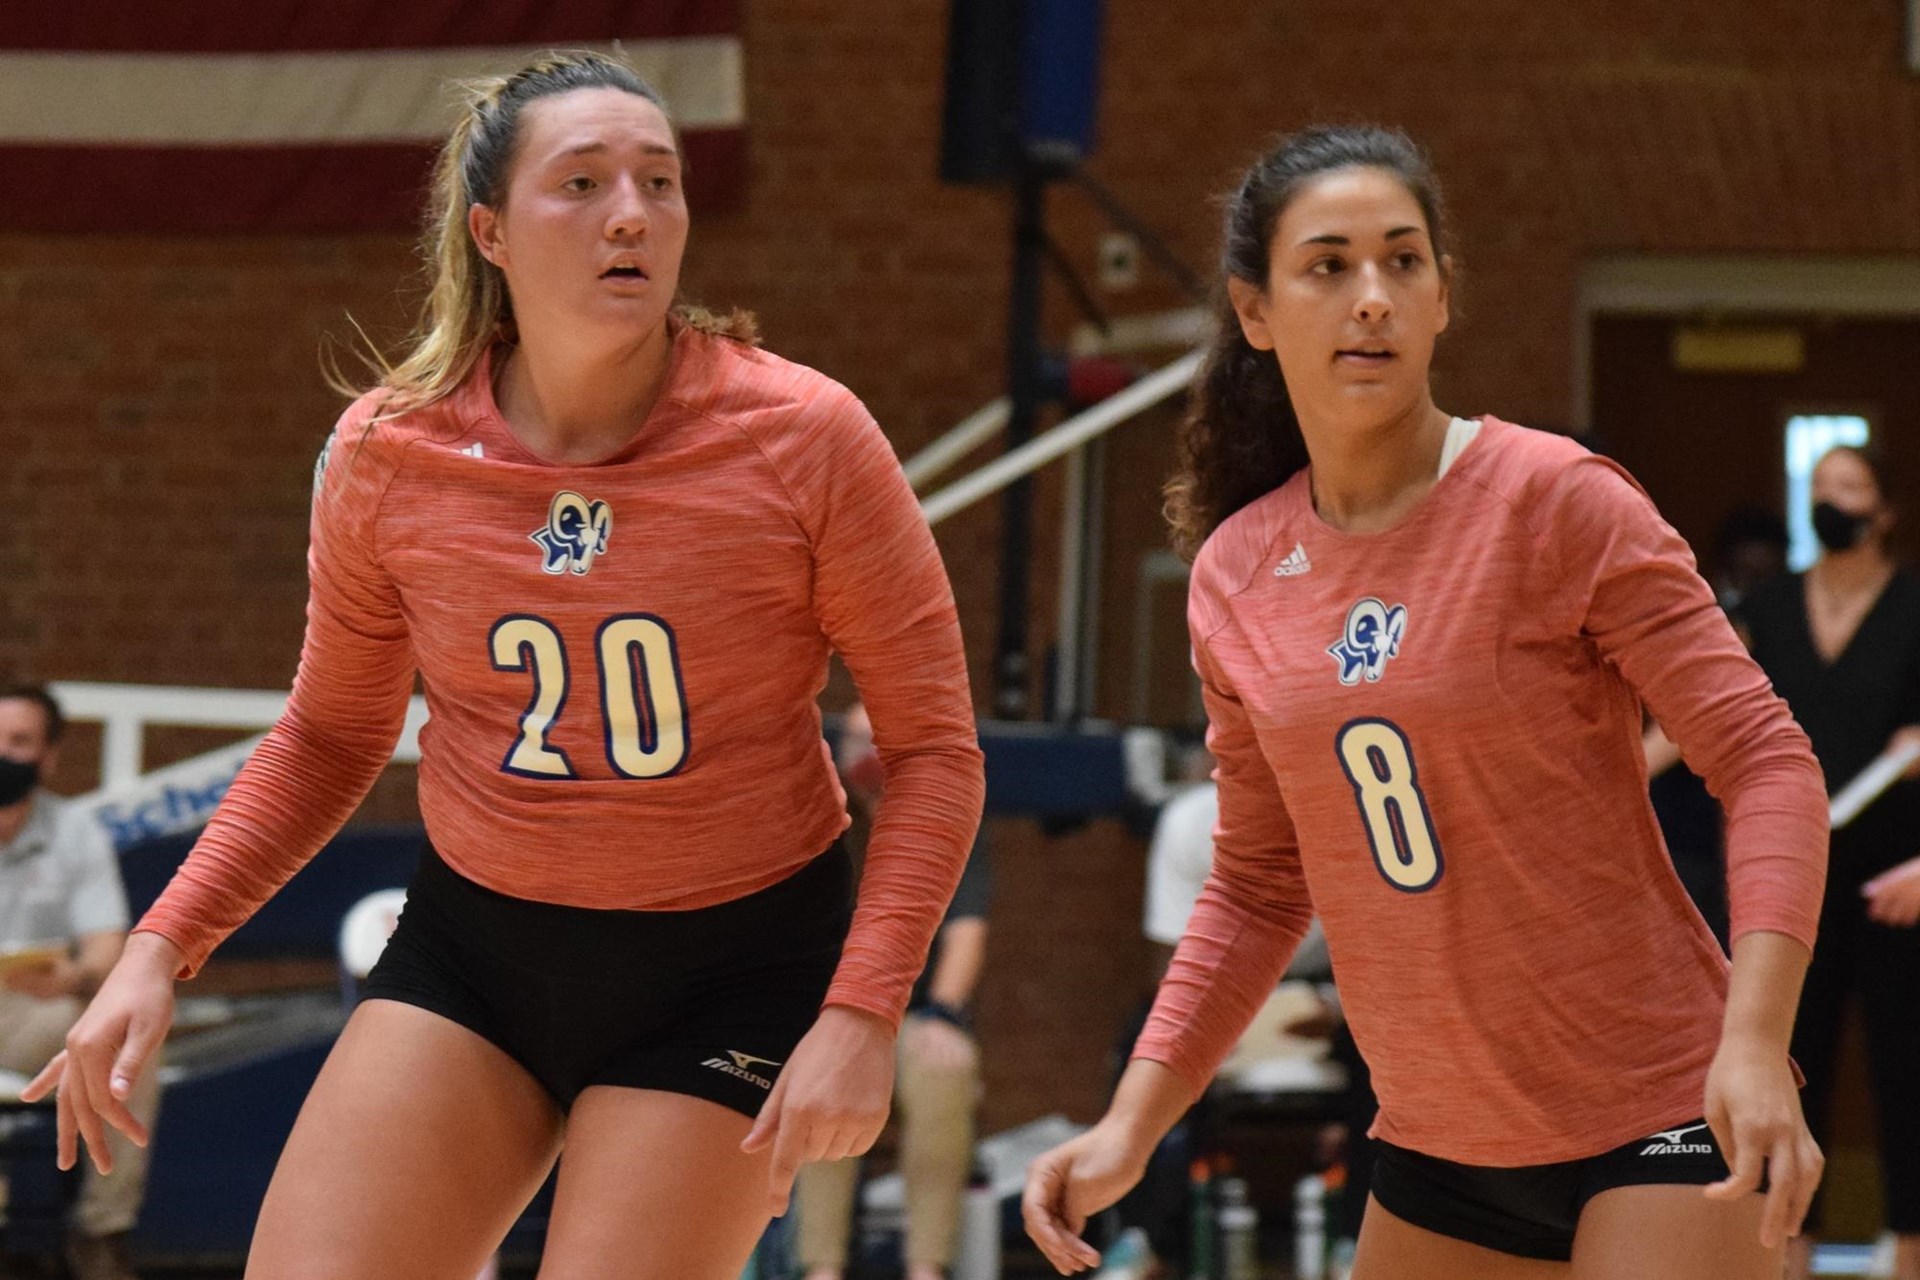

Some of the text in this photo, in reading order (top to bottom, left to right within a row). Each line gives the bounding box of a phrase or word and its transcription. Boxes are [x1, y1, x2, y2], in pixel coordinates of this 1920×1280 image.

[1273, 562, 1311, 576] adidas
[488, 612, 691, 779] 20
[1335, 716, 1445, 893] 8
